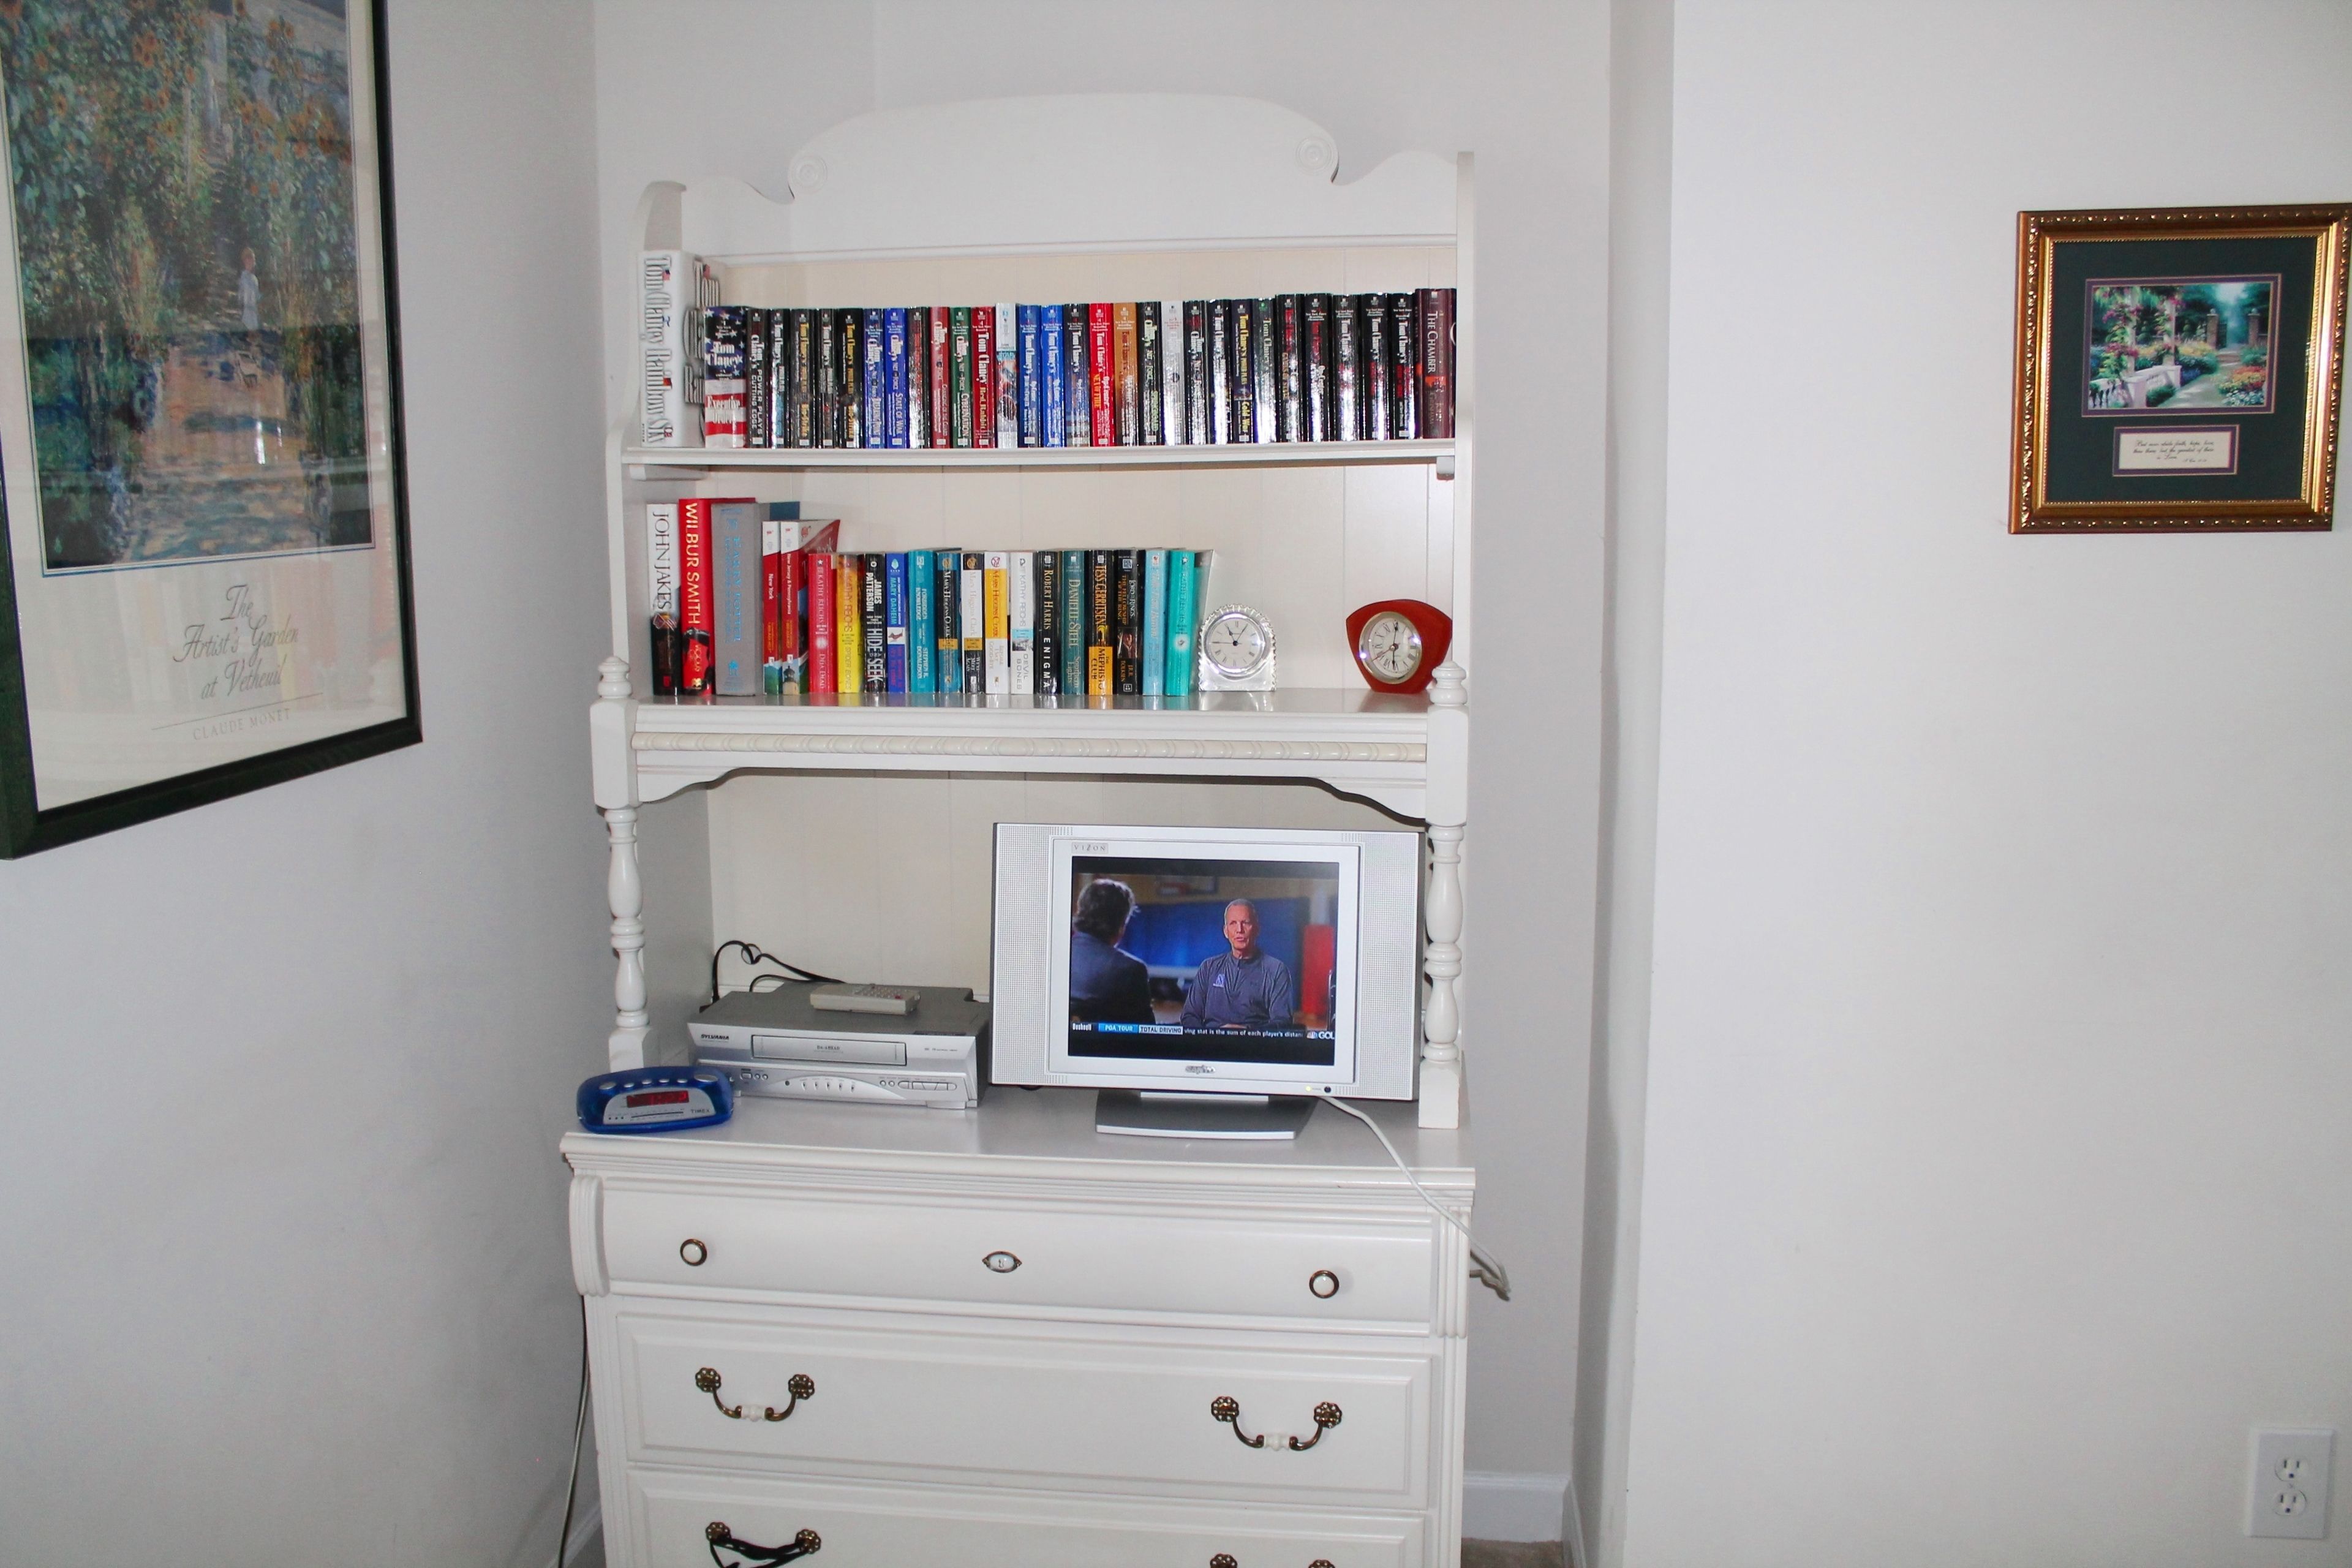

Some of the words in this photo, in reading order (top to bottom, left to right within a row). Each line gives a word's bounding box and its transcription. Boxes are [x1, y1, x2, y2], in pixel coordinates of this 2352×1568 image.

[645, 256, 671, 289] Tom
[646, 292, 672, 343] Clancy
[847, 324, 856, 338] Tom
[1239, 314, 1248, 328] Tom
[1263, 318, 1272, 336] Tom
[1372, 318, 1381, 332] Tom
[1398, 322, 1408, 335] Tom
[1427, 311, 1438, 329] THE
[712, 341, 735, 354] Tom
[888, 334, 899, 361] Clancy's
[932, 321, 943, 351] Clancy's
[954, 336, 965, 363] Clancy's
[978, 333, 989, 352] Tom
[1025, 334, 1035, 349] Tom
[1049, 332, 1058, 346] Tom
[1072, 331, 1081, 345] Tom
[1188, 331, 1200, 359] Clancy's
[1238, 330, 1249, 356] Clancy's
[1370, 333, 1382, 360] Clancy's
[1397, 336, 1408, 363] Clancy's
[704, 354, 744, 368] Clancy
[750, 334, 761, 369] Clancy's
[822, 339, 832, 366] Clancy's
[845, 339, 856, 364] Clancy's
[865, 337, 875, 371] Clancy's
[1023, 349, 1035, 374] Clancy's
[1047, 346, 1058, 373] Clancy's
[1071, 345, 1081, 372] Clancy's
[1096, 346, 1105, 372] Clancy's
[1262, 337, 1273, 370] Clancy's
[1427, 331, 1438, 373] CHAMBER
[646, 349, 673, 415] Rainbow
[976, 354, 990, 384] Clancy
[707, 394, 741, 409] Executive
[1241, 402, 1250, 416] Cold
[646, 418, 673, 443] Six
[653, 512, 671, 561] JOHN
[685, 503, 699, 567] WILBUR
[733, 537, 742, 585] HARRY
[1095, 565, 1106, 582] TESS
[654, 565, 672, 610] JAKES
[685, 571, 701, 624] SMITH
[844, 575, 853, 602] KATHY
[865, 572, 875, 612] PATTERSON
[1044, 570, 1054, 599] ROBERT
[1118, 581, 1122, 589] OF
[220, 583, 254, 622] The
[968, 590, 977, 616] Higgins
[1068, 579, 1081, 622] DANIELLE
[1095, 583, 1106, 625] GERRITSEN
[844, 605, 853, 632] REICHS
[1044, 601, 1054, 630] HARRIS
[173, 624, 239, 663] Artist's
[248, 614, 300, 667] Garden
[867, 628, 883, 652] HIDE
[1068, 622, 1081, 648] STEEL
[201, 676, 218, 700] at
[224, 654, 287, 696] Vetheuil
[867, 658, 883, 682] SEEK
[1066, 661, 1076, 684] Lights
[1072, 656, 1082, 688] Southern
[193, 718, 244, 741] CLAUDE
[249, 708, 290, 728] MONET
